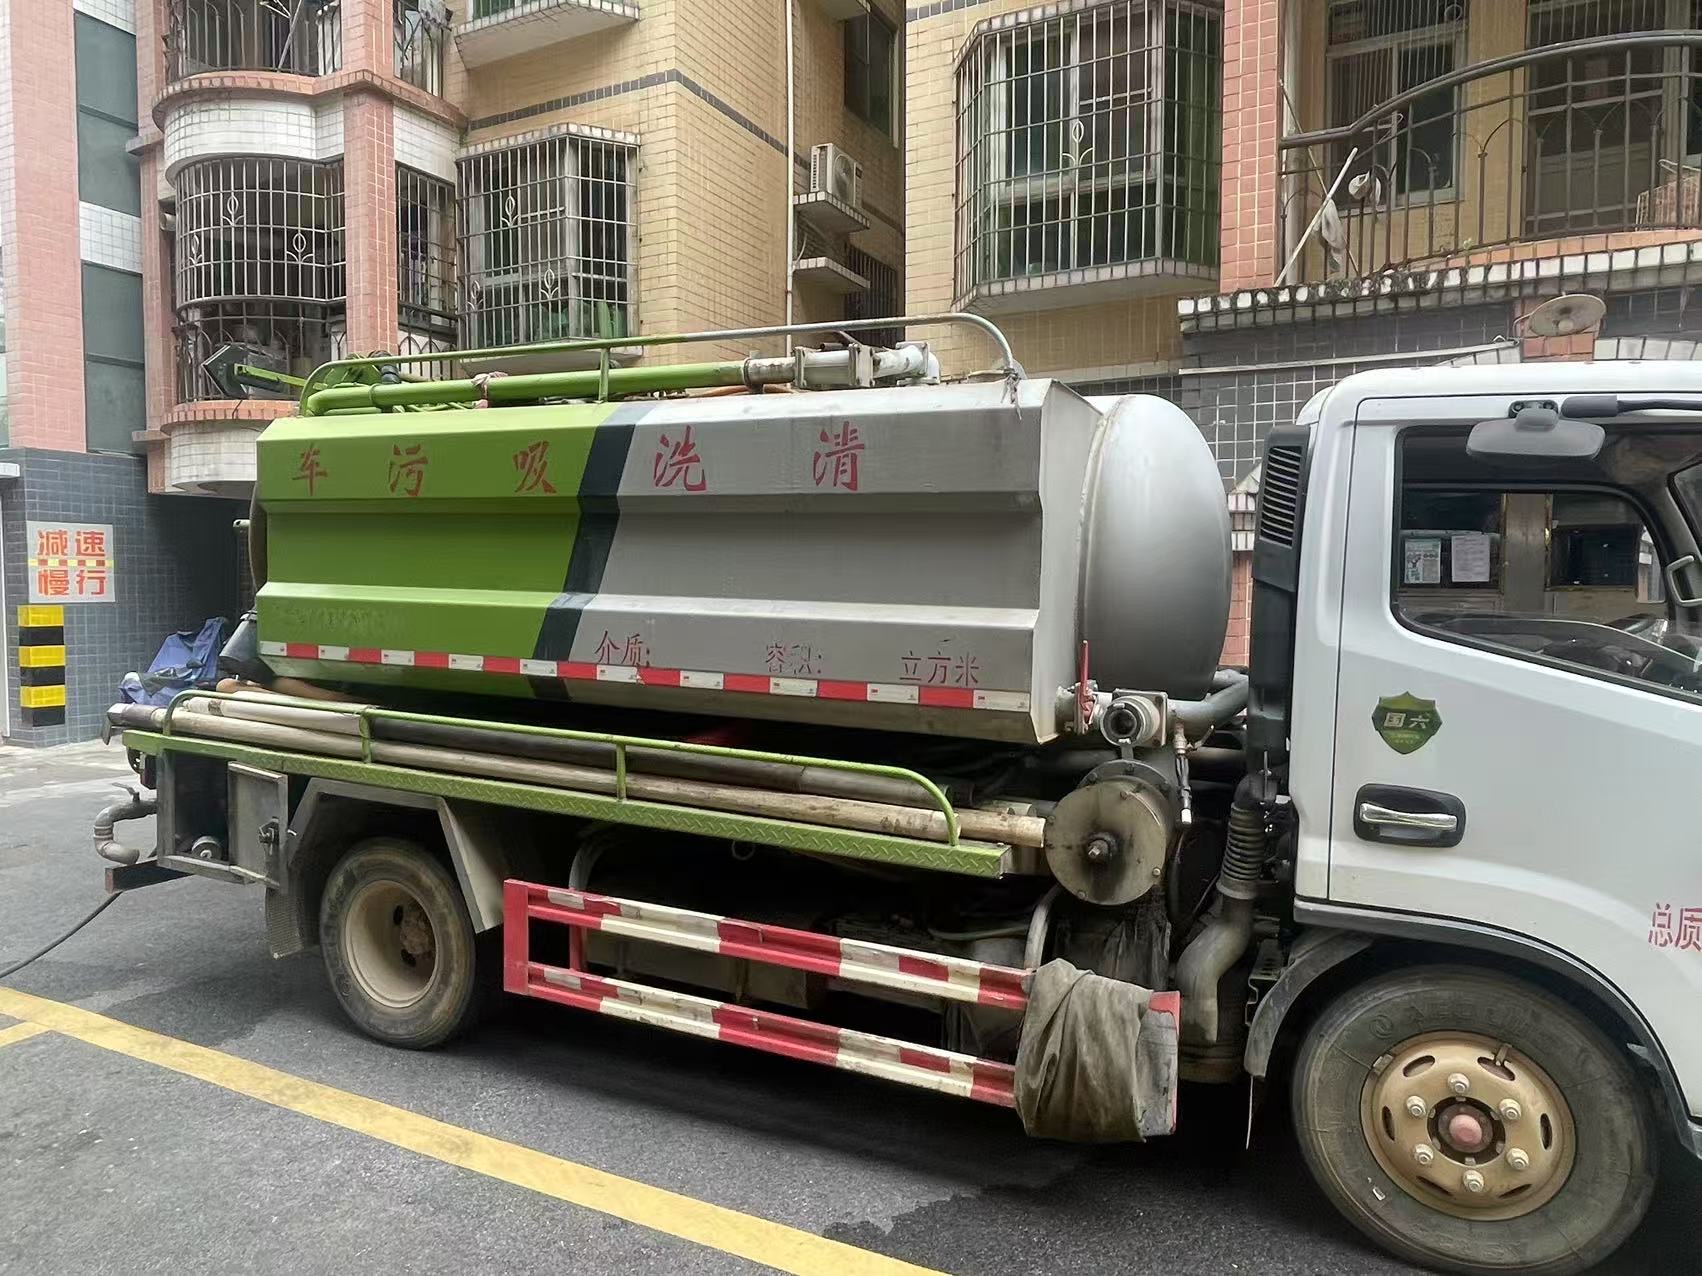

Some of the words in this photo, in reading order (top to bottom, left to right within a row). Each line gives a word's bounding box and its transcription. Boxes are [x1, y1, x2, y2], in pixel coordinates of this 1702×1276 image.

[37, 529, 107, 557] 减速
[37, 569, 107, 596] 慢行
[900, 650, 979, 687] 立方米
